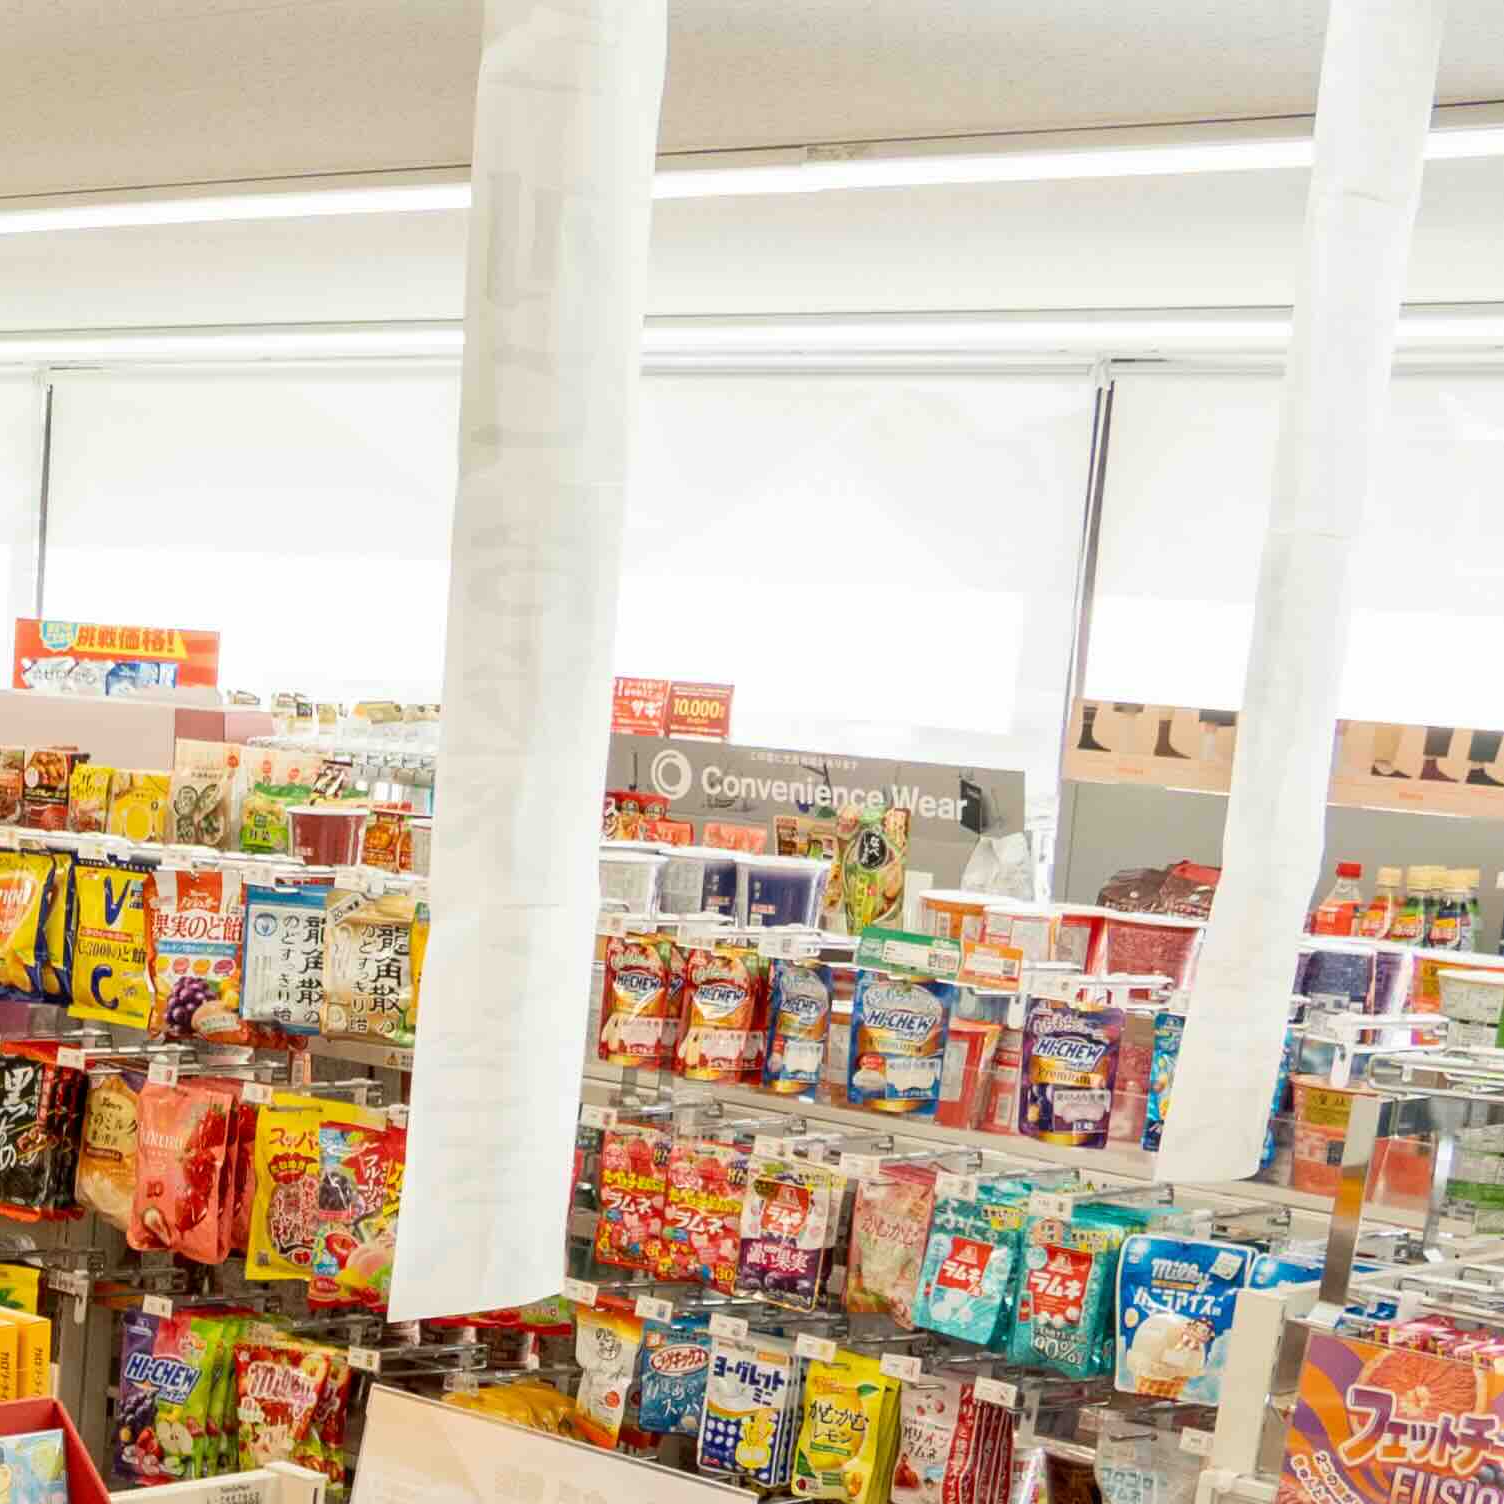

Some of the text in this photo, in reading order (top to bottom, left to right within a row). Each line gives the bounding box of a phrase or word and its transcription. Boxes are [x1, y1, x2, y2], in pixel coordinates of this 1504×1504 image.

[701, 765, 967, 820] Convenience Wear
[152, 913, 243, 941] 果実のど飴
[864, 1009, 935, 1030] HI-CHEW
[1036, 1037, 1105, 1061] HI-CHEW
[672, 1213, 726, 1234] ラムネ
[1029, 1270, 1083, 1300] ラムネ
[126, 1353, 201, 1392] HI-CHEW
[712, 1357, 787, 1391] ヨーグレット
[808, 1400, 869, 1432] かむかむ
